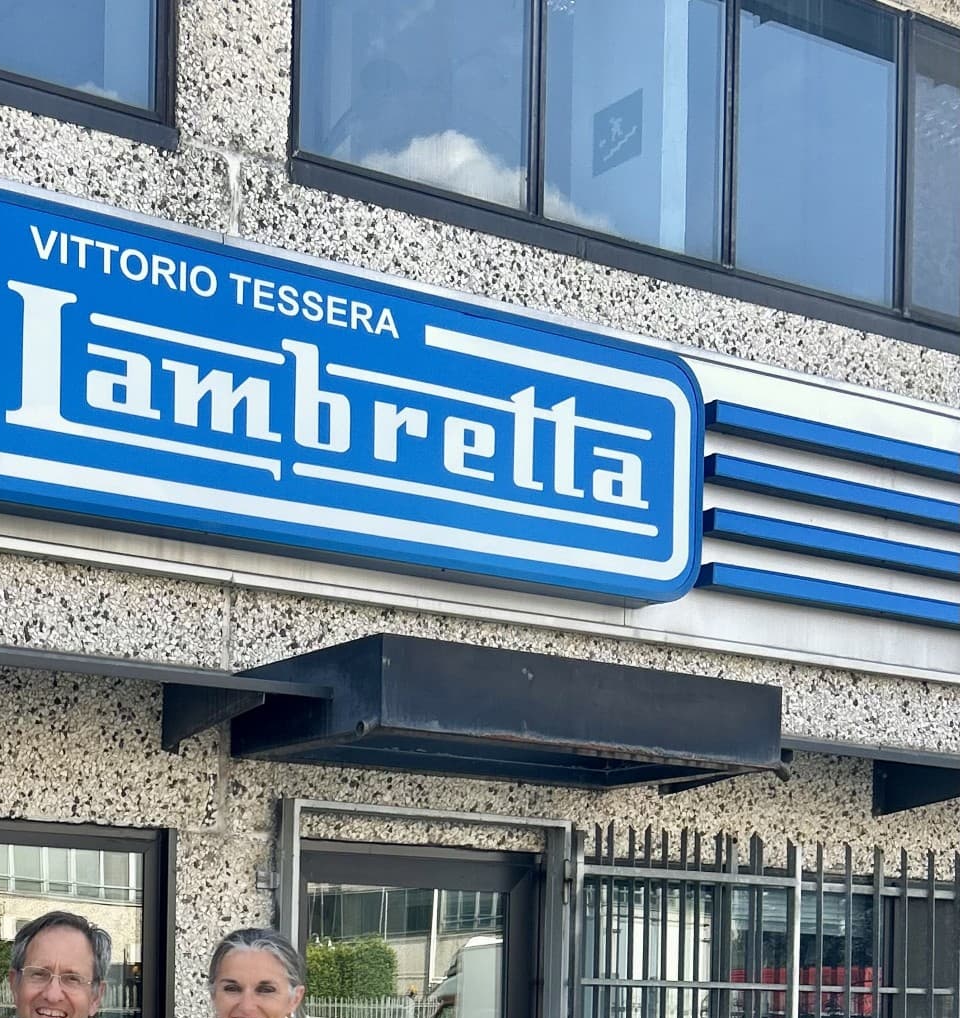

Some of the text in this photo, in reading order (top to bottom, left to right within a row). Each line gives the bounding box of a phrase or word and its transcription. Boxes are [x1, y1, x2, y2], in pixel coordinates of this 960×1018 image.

[30, 226, 400, 340] VITTORIO TESSERA
[7, 280, 658, 537] Lambretta
